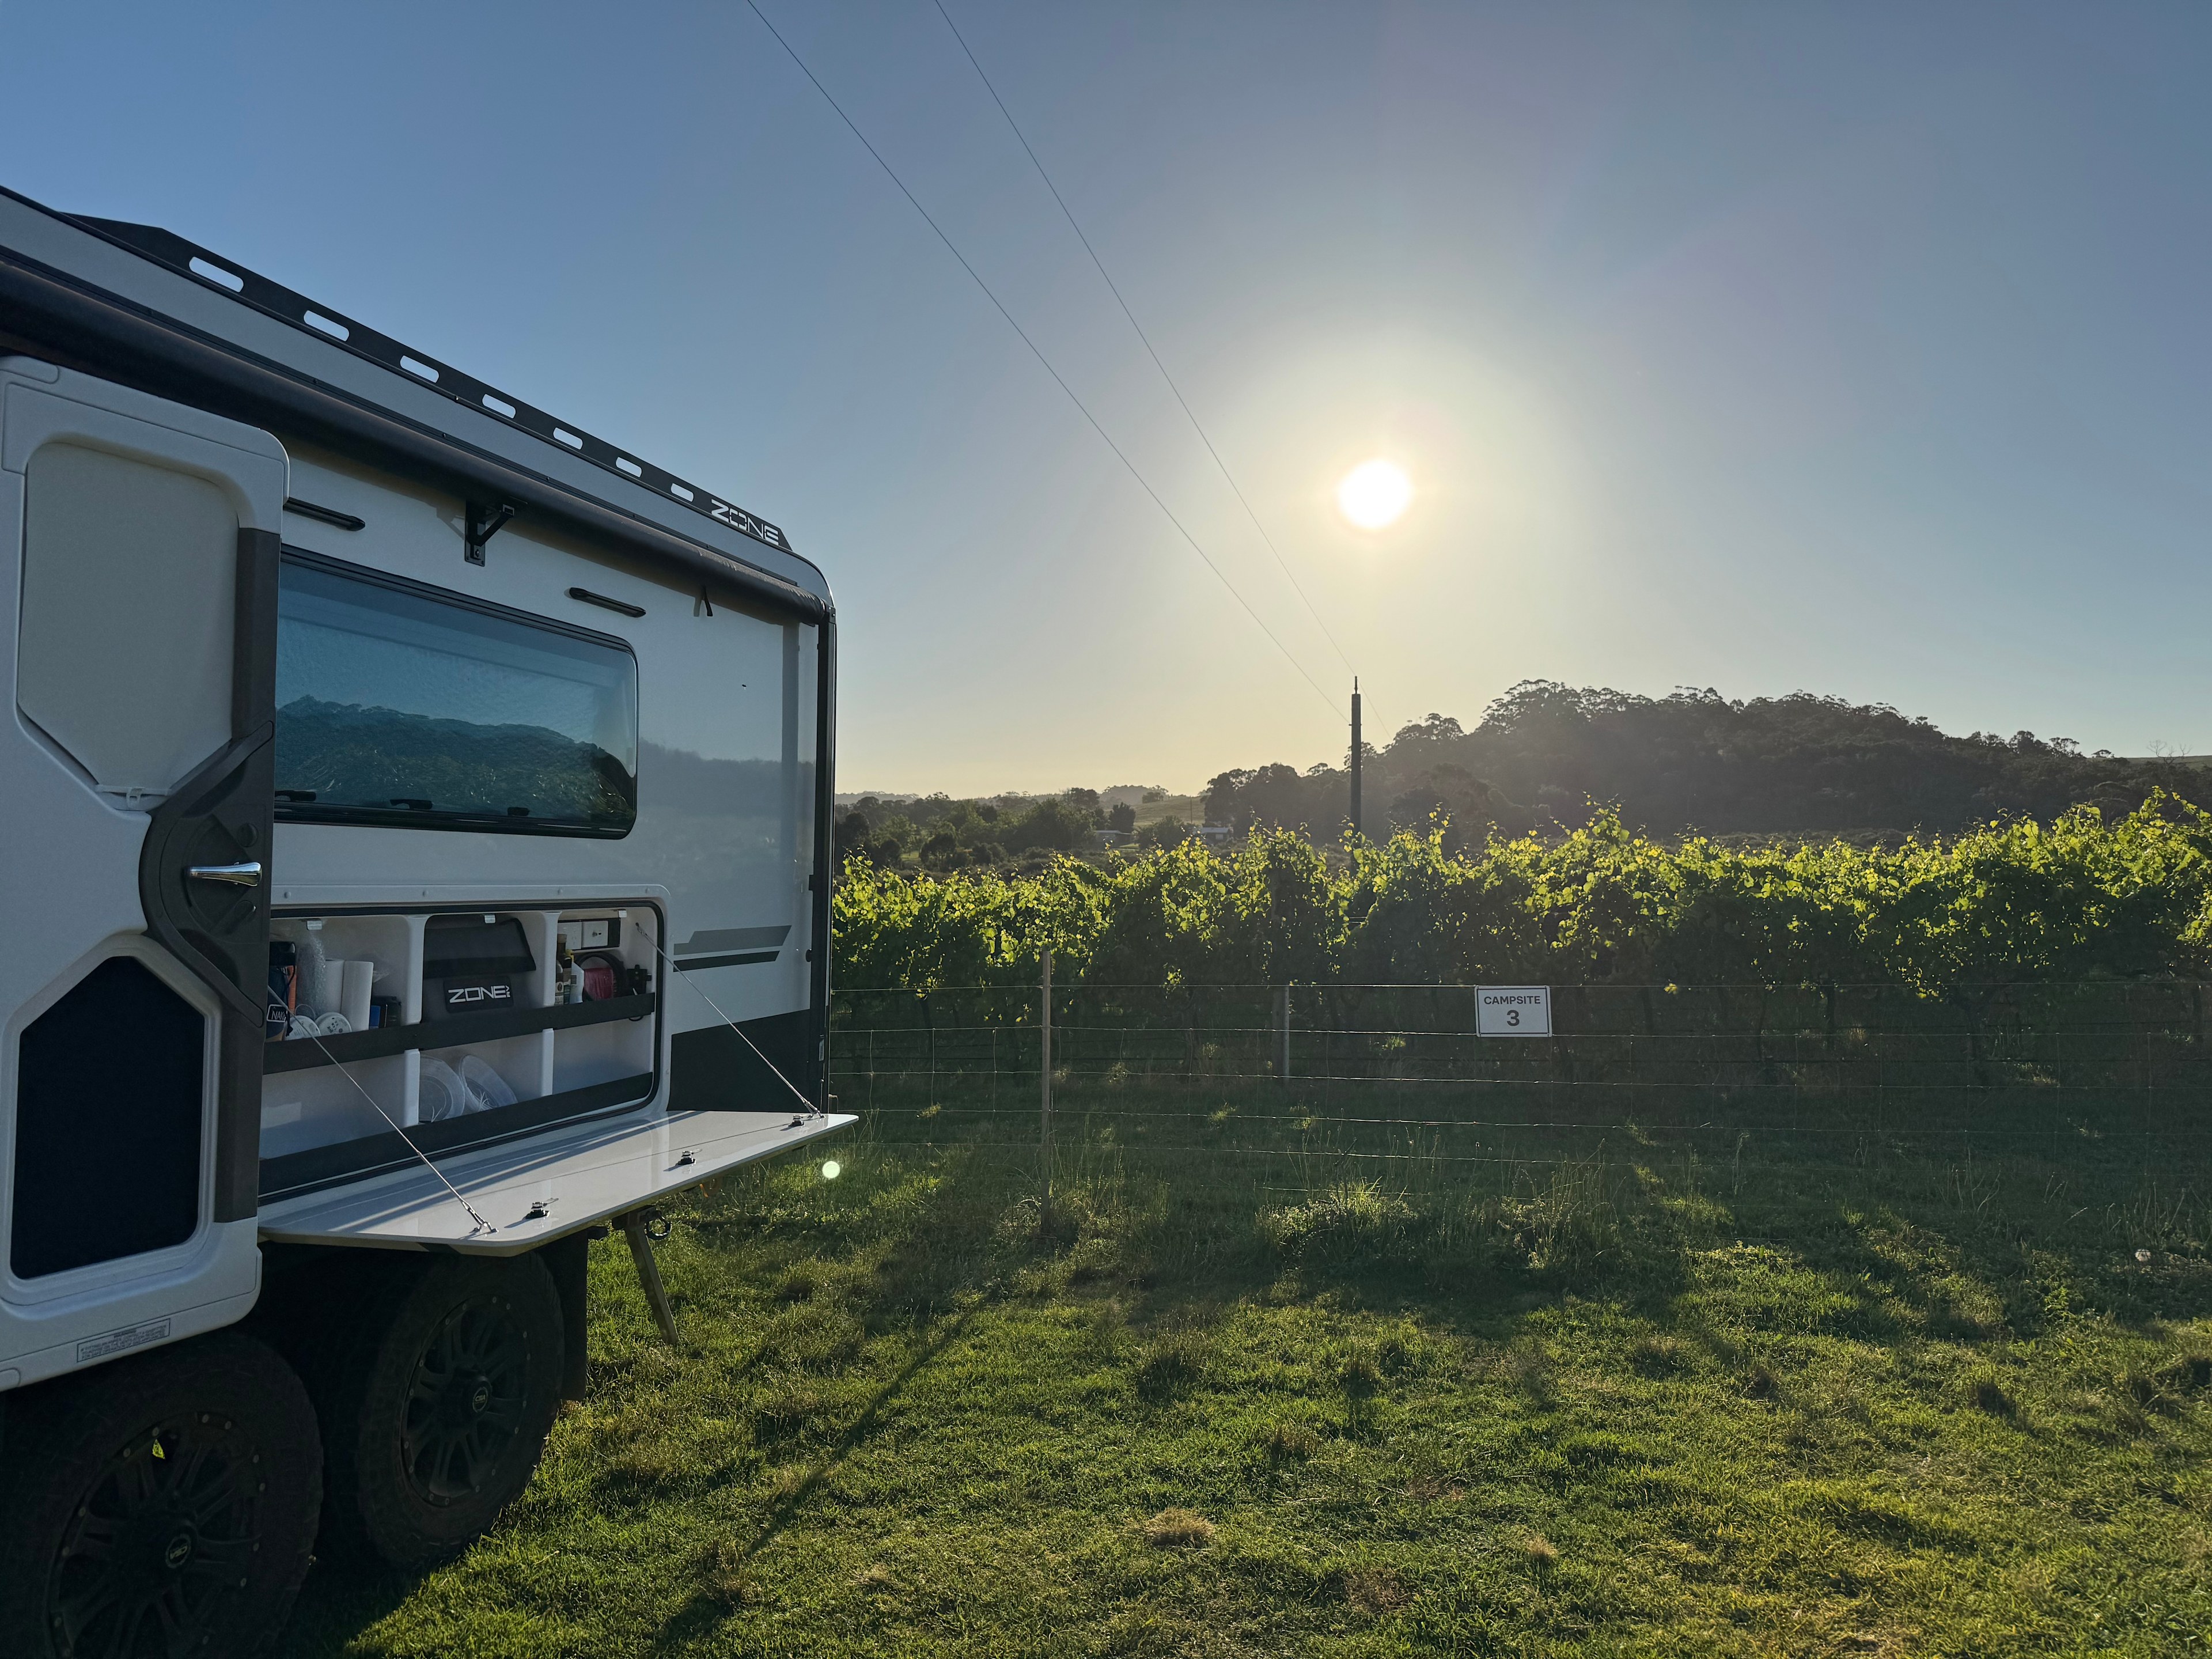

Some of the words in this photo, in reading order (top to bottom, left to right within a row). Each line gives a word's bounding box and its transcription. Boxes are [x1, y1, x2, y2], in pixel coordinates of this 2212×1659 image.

[711, 499, 779, 546] ZONE
[448, 985, 506, 1003] ZONE
[1484, 996, 1541, 1005] CAMPSITE
[1506, 1010, 1520, 1026] 3
